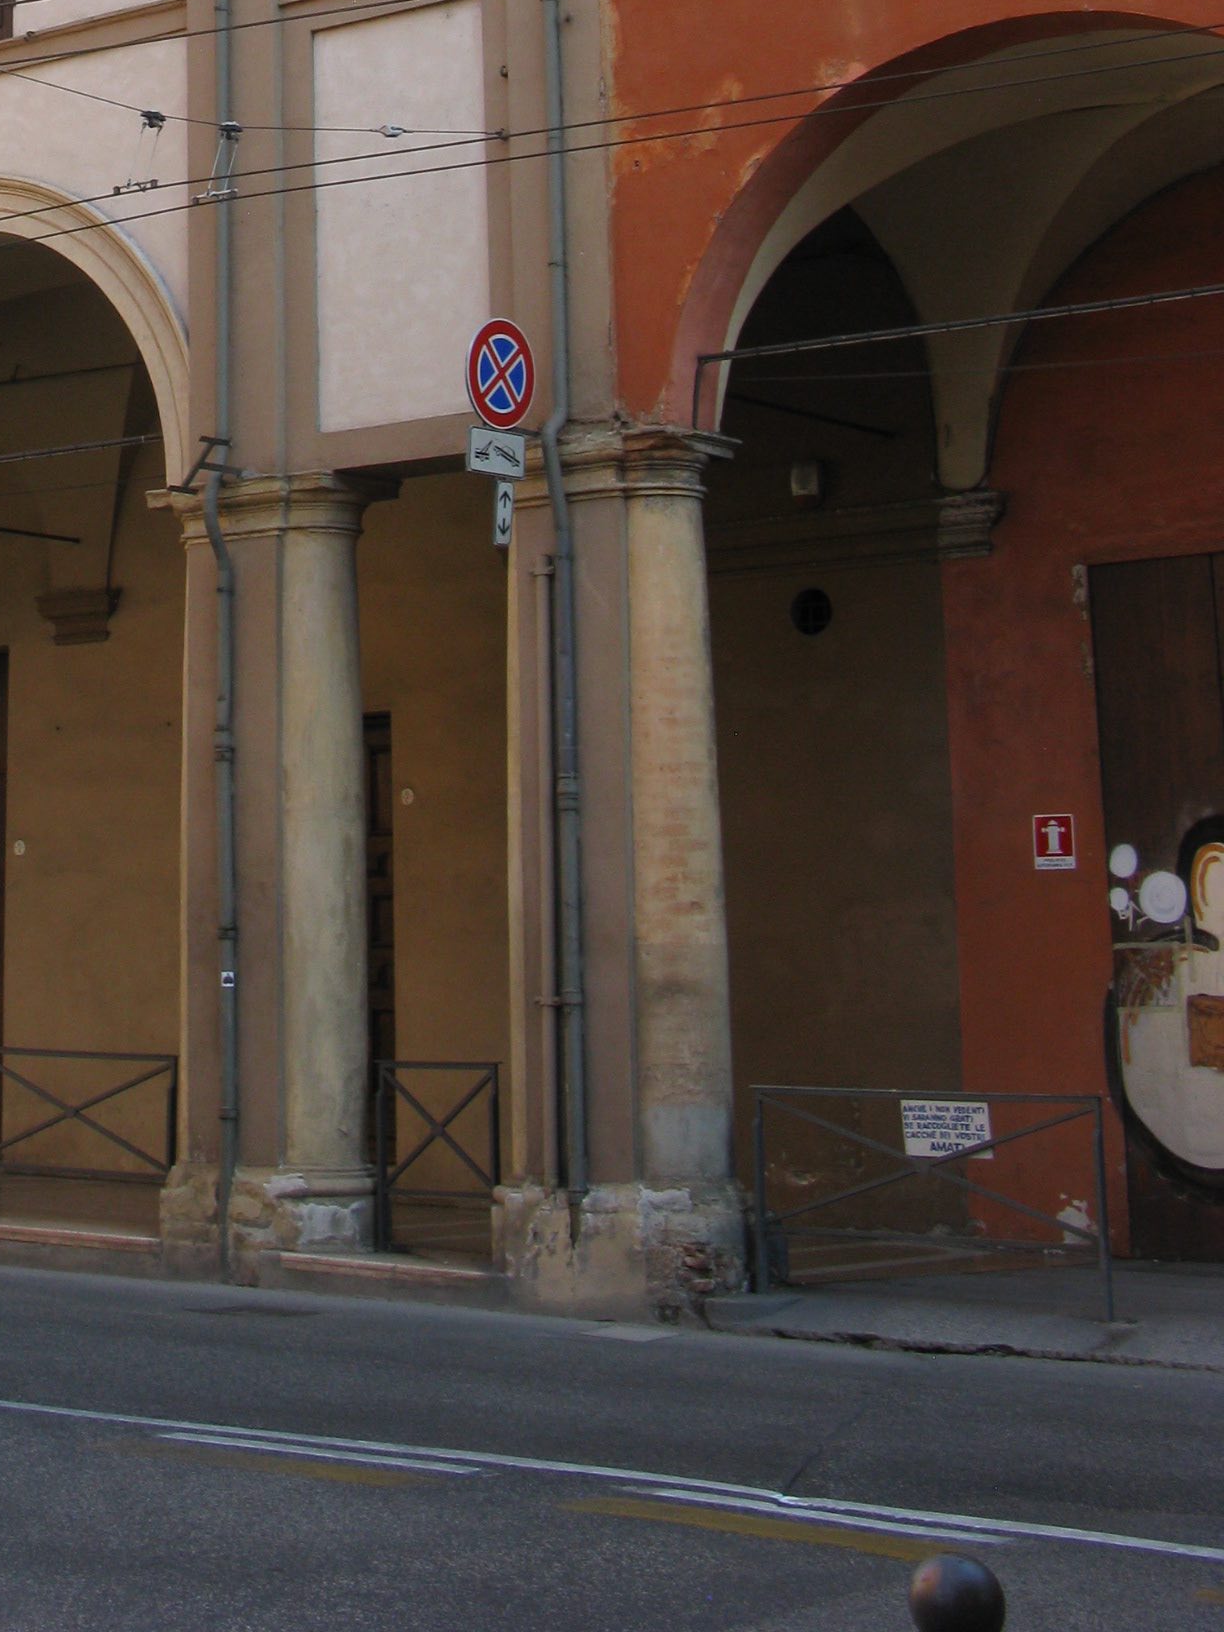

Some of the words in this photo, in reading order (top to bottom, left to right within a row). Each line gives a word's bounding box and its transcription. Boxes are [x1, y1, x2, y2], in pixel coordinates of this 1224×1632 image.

[903, 1105, 927, 1113] ANCHE
[935, 1105, 951, 1113] NON
[953, 1106, 985, 1115] VEDENTI
[904, 1122, 914, 1130] SE
[917, 1122, 971, 1132] RACCOGLIETE
[975, 1124, 986, 1132] LE
